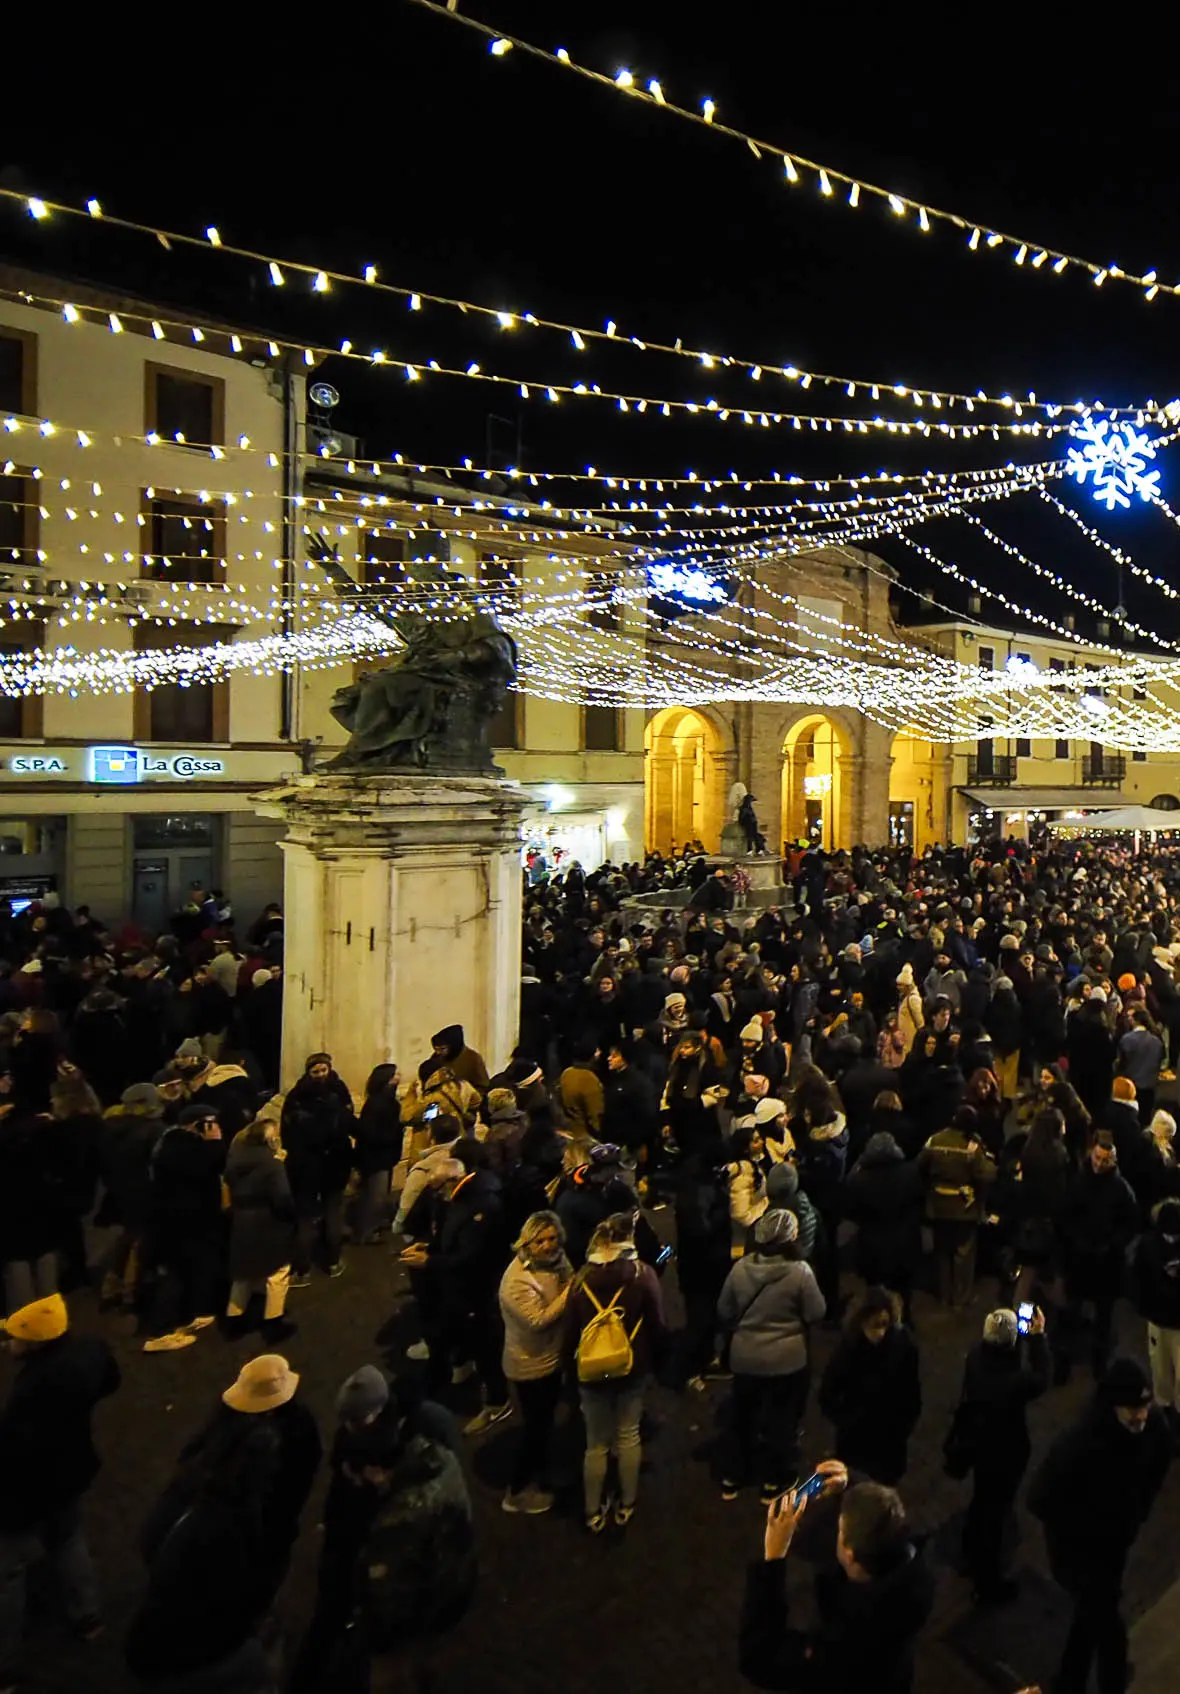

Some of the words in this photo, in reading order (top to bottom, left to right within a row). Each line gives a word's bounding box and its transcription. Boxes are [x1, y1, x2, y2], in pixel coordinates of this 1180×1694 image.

[15, 759, 69, 770] S.P.A.
[143, 757, 168, 770] La
[173, 756, 222, 776] Cassa
